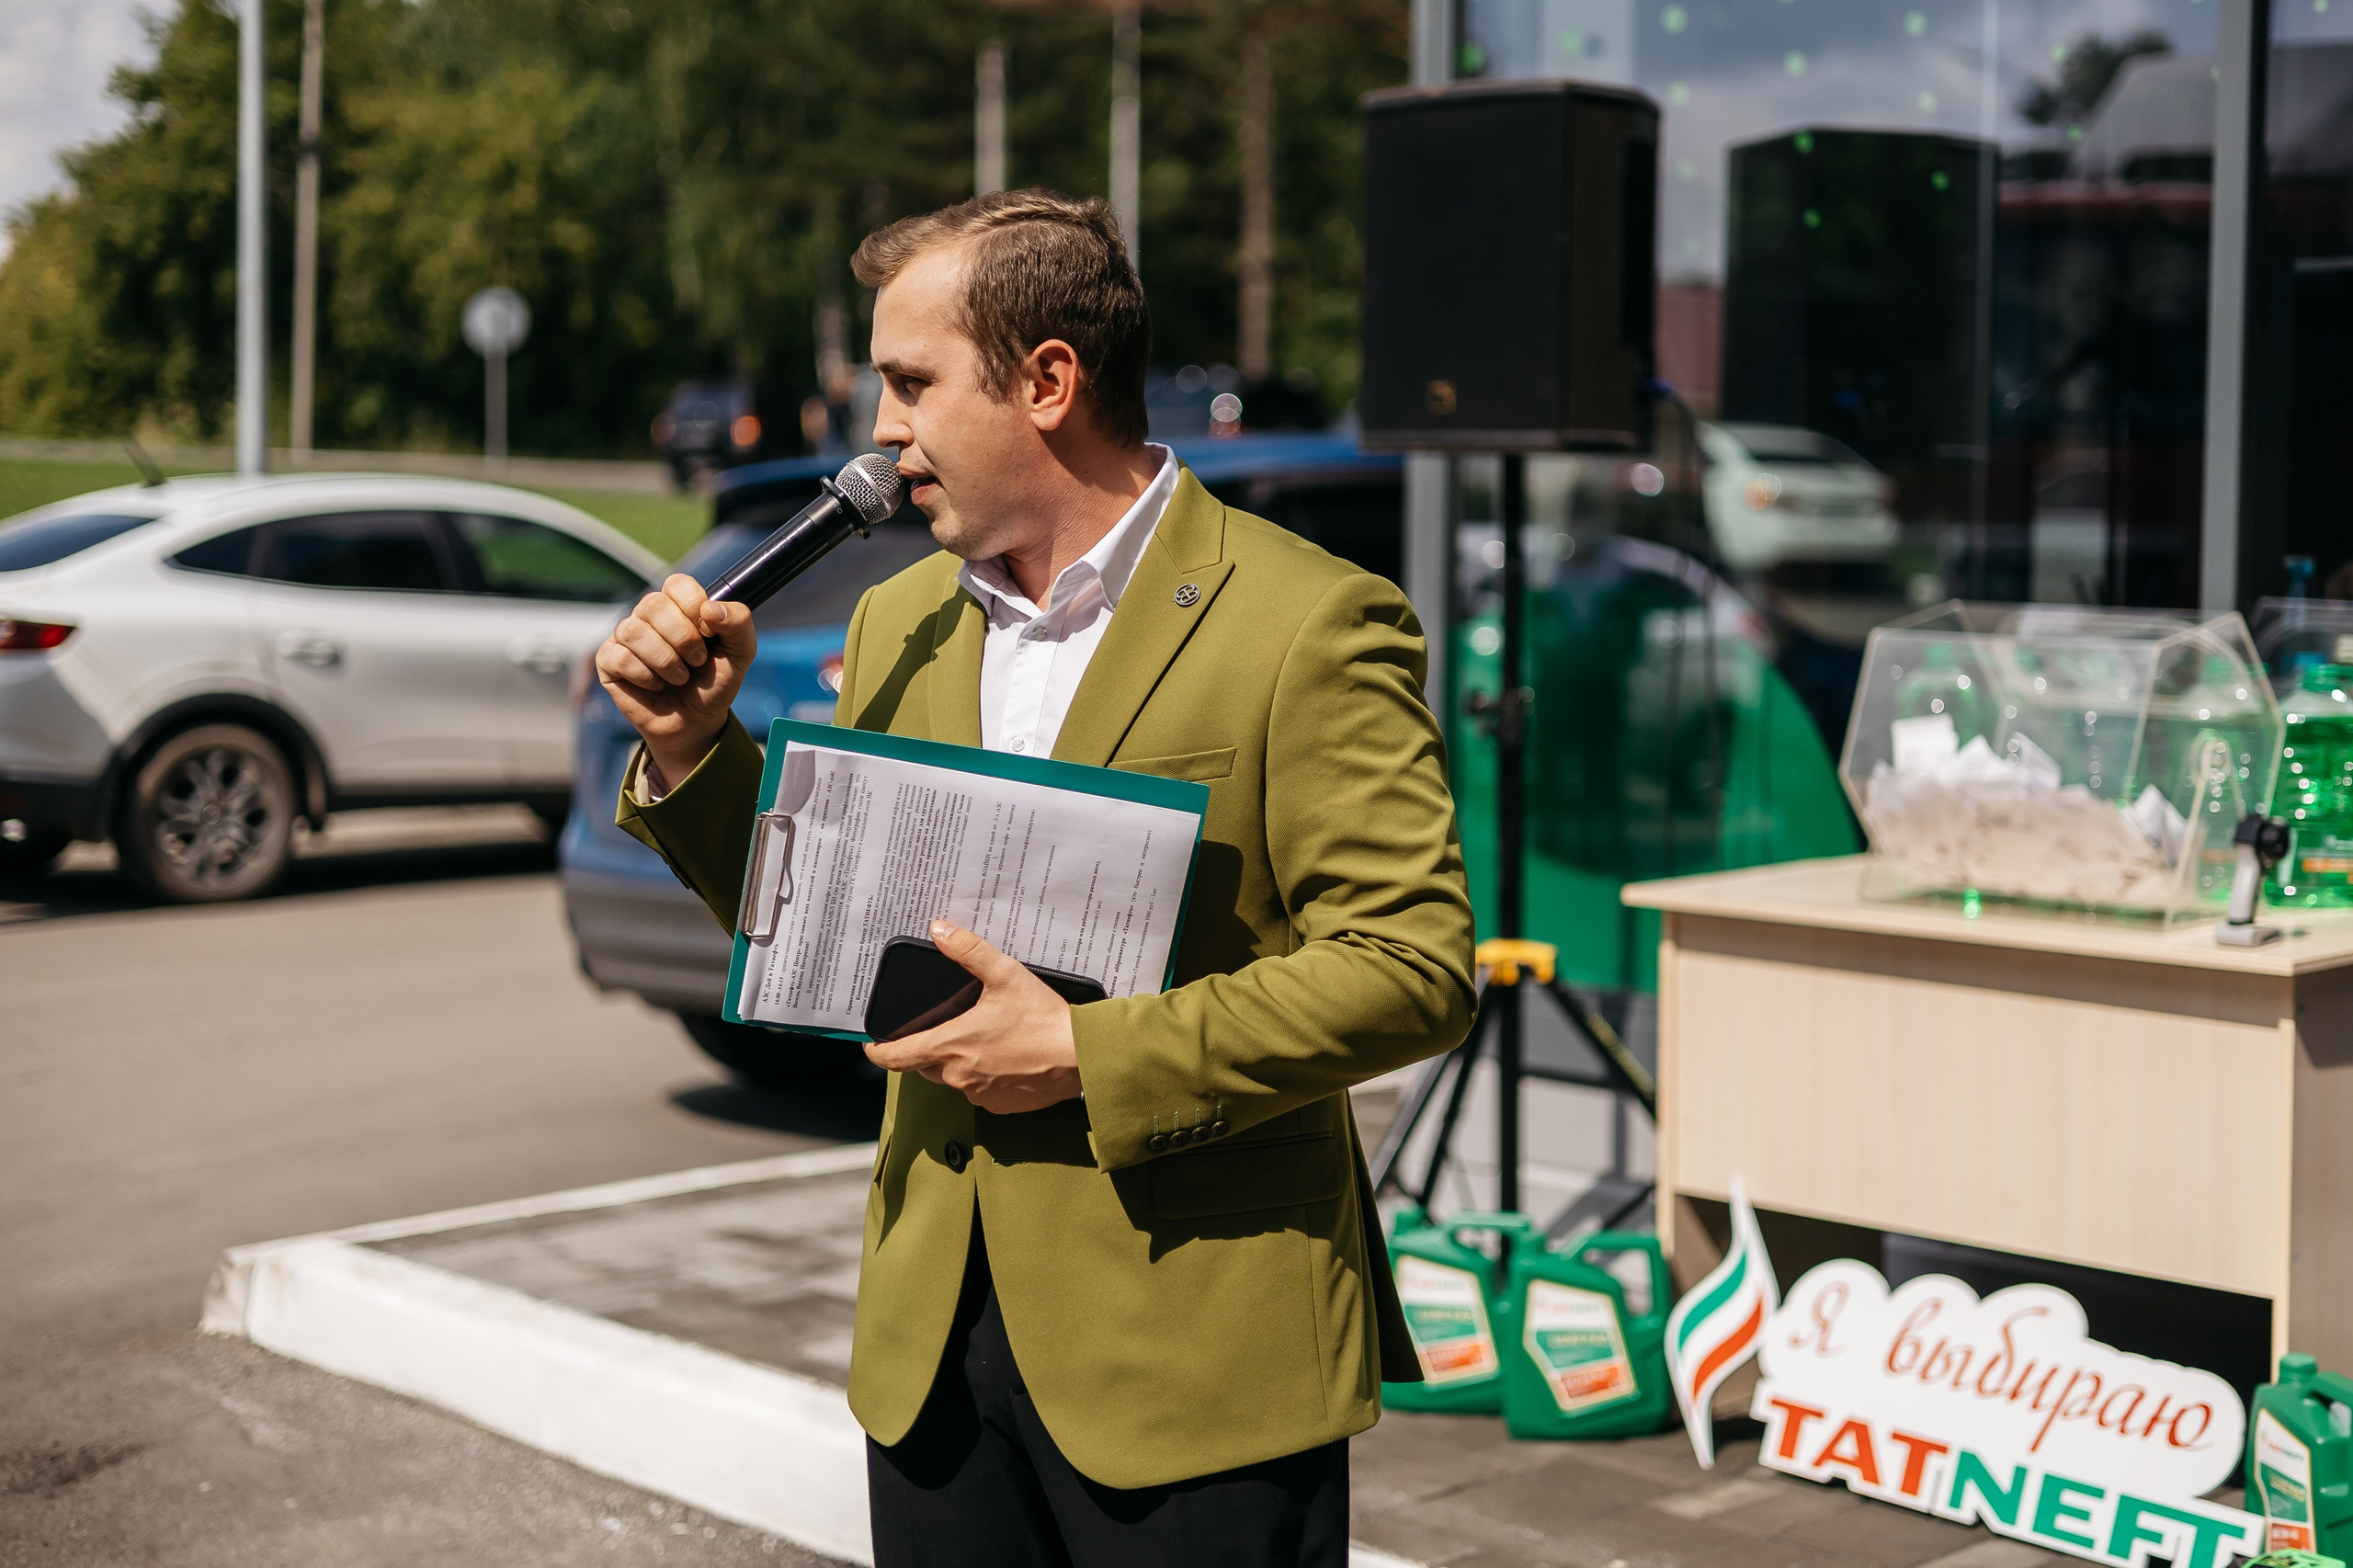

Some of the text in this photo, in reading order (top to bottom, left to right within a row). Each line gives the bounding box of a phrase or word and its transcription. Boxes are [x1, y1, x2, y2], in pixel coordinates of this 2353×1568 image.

[792, 948, 801, 967] Центр»
[798, 915, 807, 947] приглашает
[806, 874, 814, 901] водителей
[813, 837, 822, 868] пассажиров
[903, 905, 913, 936] «Татнефть»
[914, 858, 923, 879] большие
[926, 790, 937, 825] дорогостоящие
[914, 882, 925, 915] обеспечивает
[926, 835, 935, 860] приятную
[931, 808, 939, 835] стоимость.
[1123, 904, 1133, 934] «Татнефть»
[1133, 869, 1142, 889] быстрее
[1142, 829, 1153, 859] интереснее)
[761, 991, 769, 1003] АЗС
[767, 943, 779, 971] Татнефть
[800, 940, 810, 969] Интересно!
[846, 893, 873, 1015] Справочная информация бренду ТАТНЕФТЬ:
[1788, 1280, 2214, 1454] Я выбираю
[1769, 1398, 2246, 1568] TATNEFT
